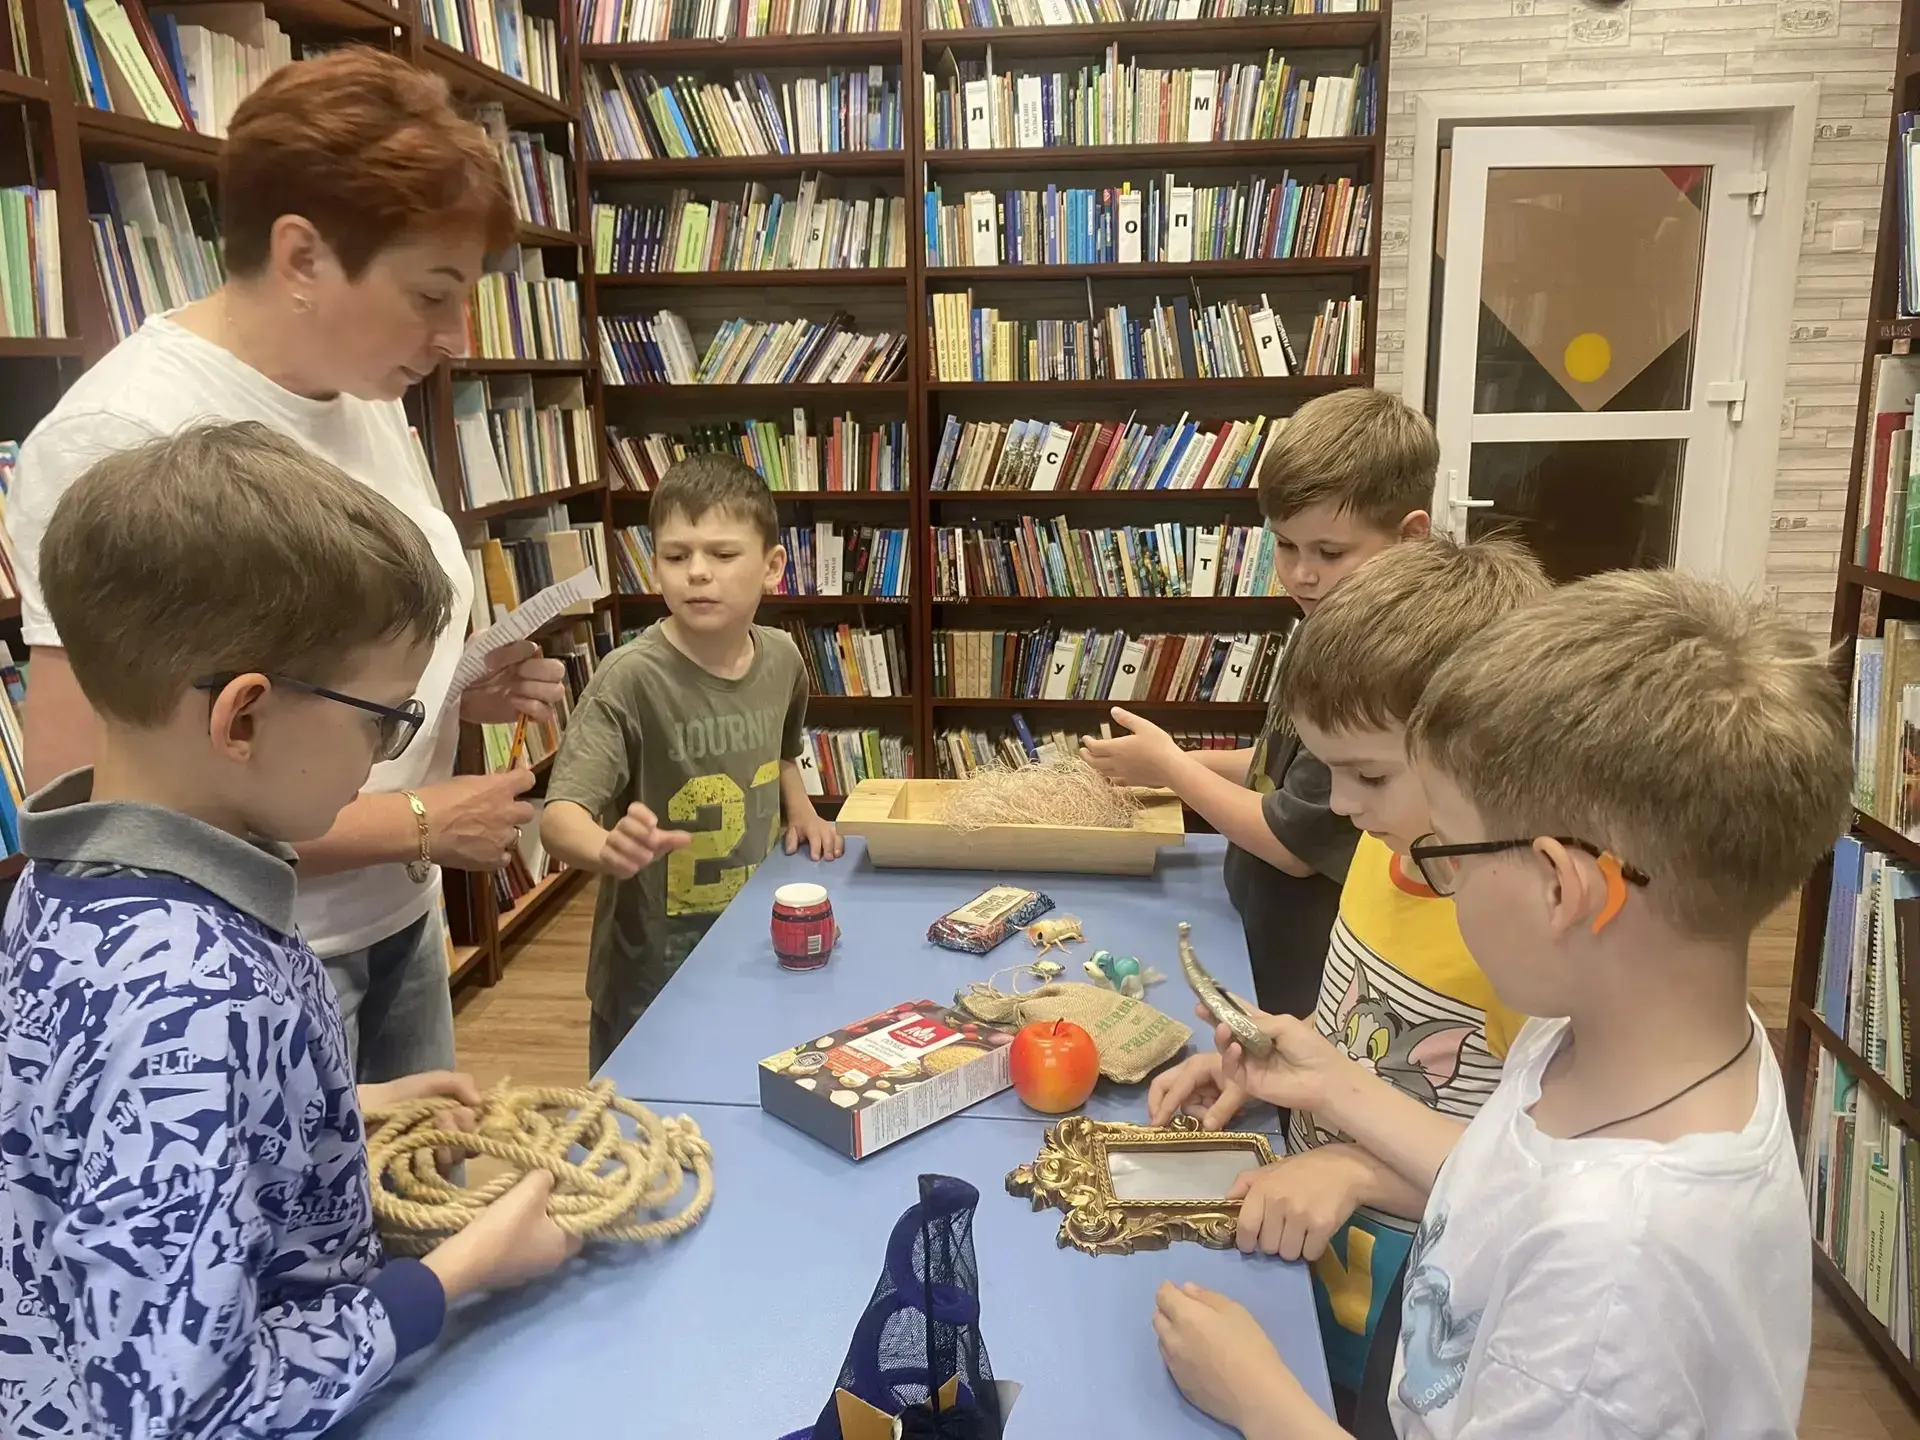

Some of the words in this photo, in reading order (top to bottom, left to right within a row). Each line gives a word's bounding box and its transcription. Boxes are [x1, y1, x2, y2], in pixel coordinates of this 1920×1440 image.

[1195, 98, 1209, 110] М
[972, 108, 983, 120] Л
[978, 219, 989, 232] Н
[1175, 214, 1187, 227] П
[1125, 221, 1137, 233] О
[812, 229, 819, 241] Б
[1262, 336, 1272, 349] Р
[1047, 452, 1058, 464] С
[1201, 558, 1211, 570] Т
[1054, 664, 1065, 674] У
[1123, 664, 1136, 674] Ф
[1231, 665, 1242, 677] Ч
[801, 758, 812, 769] К
[1901, 998, 1913, 1099] СЫКТЫВКАР
[147, 1050, 201, 1077] FLIP
[1877, 1209, 1886, 1262] природы
[1868, 1230, 1876, 1272] Охрана
[1412, 1372, 1456, 1409] GLORIA
